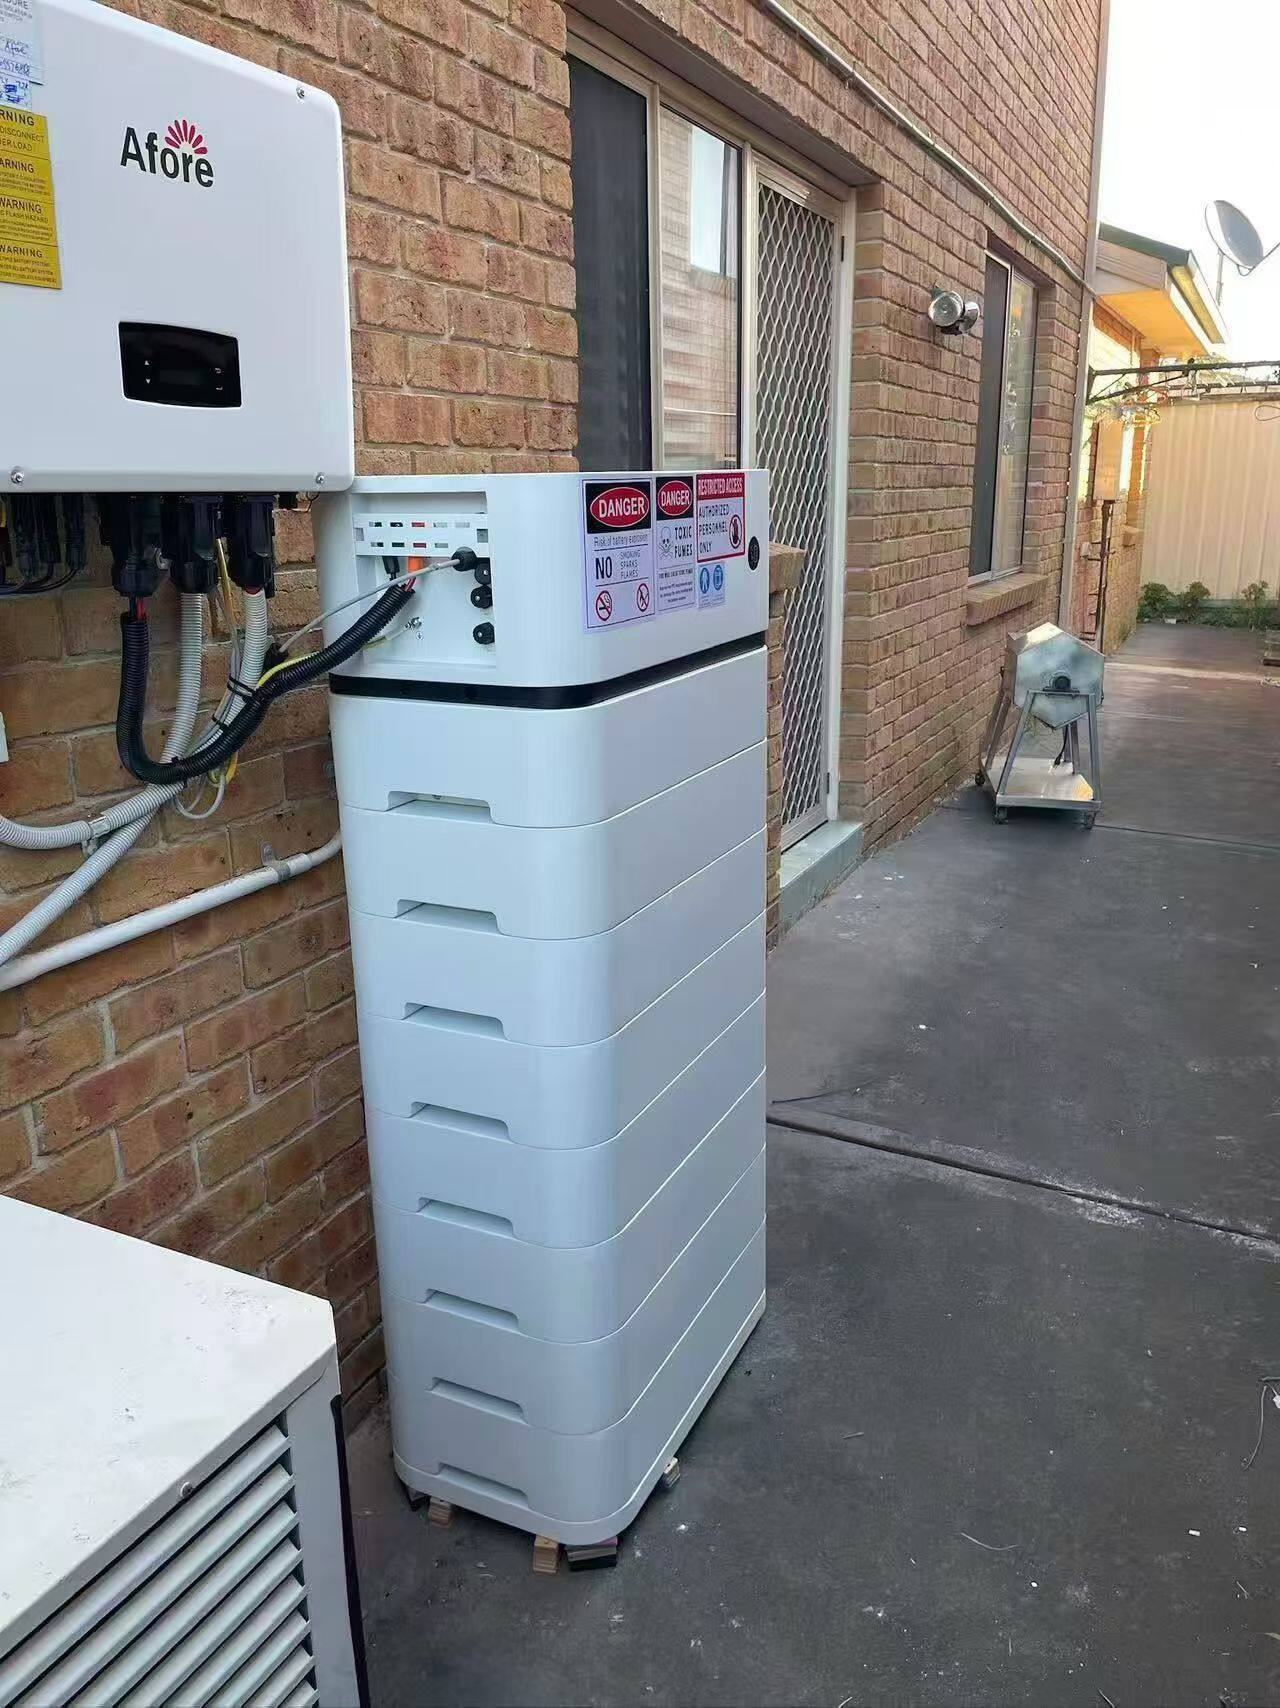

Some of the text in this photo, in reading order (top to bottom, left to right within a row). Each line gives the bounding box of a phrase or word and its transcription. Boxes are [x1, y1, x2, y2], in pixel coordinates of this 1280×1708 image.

[120, 126, 214, 188] Afore
[698, 477, 743, 496] RESTRICTED ACCESS
[660, 490, 690, 507] DANGER
[598, 496, 646, 518] DANGER
[699, 503, 730, 518] AUTHORIZED
[674, 525, 692, 540] TOXIC
[699, 521, 728, 536] PERSONNEL
[593, 536, 606, 547] Risk
[699, 540, 713, 554] ONLY
[674, 544, 693, 559] FUMES
[595, 556, 613, 580] NO
[620, 559, 638, 570] SPARKS
[620, 568, 639, 579] FLAMES
